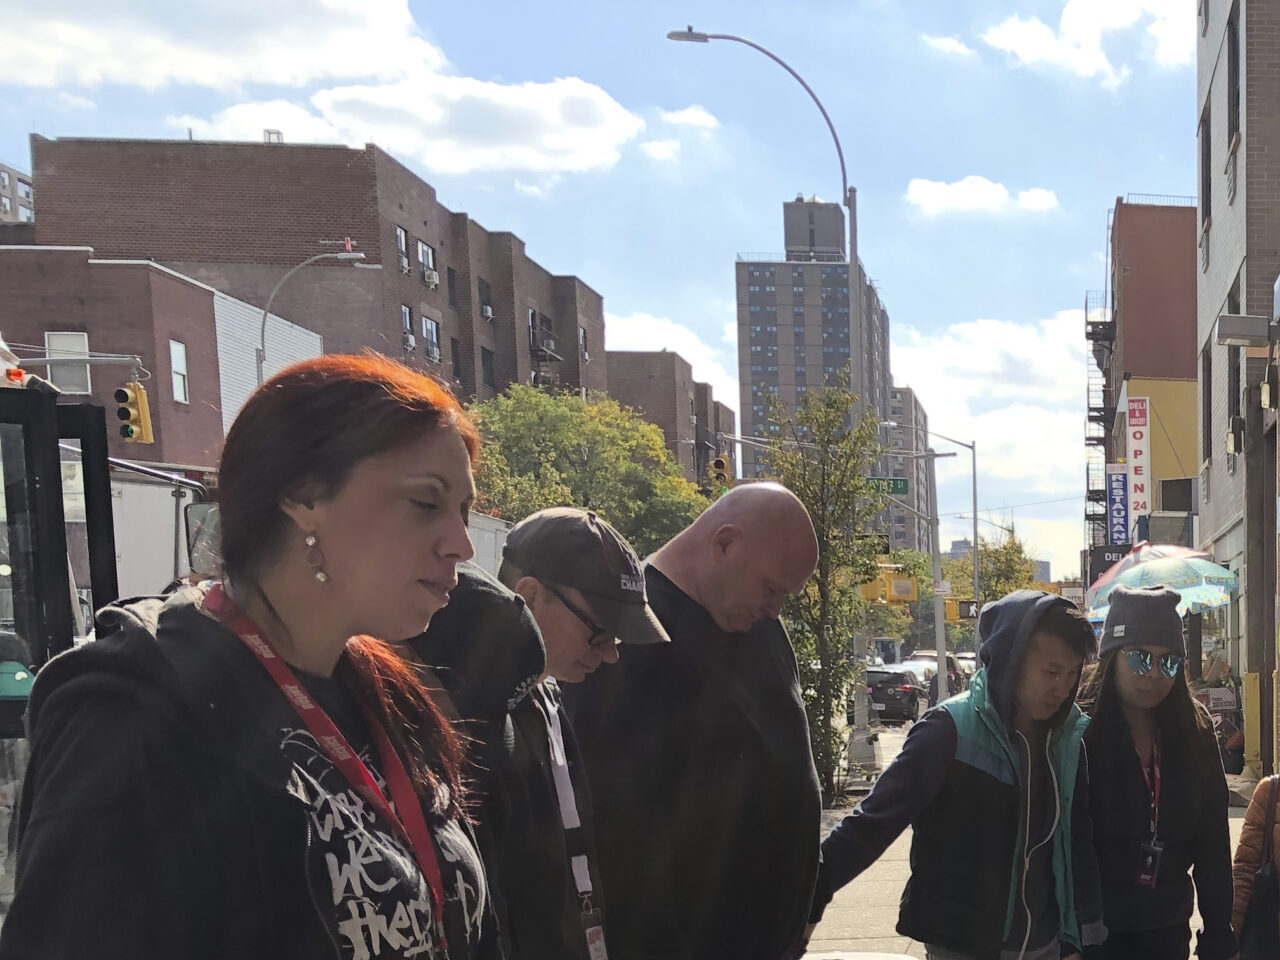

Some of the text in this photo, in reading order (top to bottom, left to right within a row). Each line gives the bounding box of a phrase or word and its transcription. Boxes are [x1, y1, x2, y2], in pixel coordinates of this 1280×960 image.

[1129, 402, 1146, 410] DELI
[1132, 430, 1145, 493] OPEN
[1111, 474, 1126, 546] RESTAURANT
[1133, 501, 1147, 511] 24
